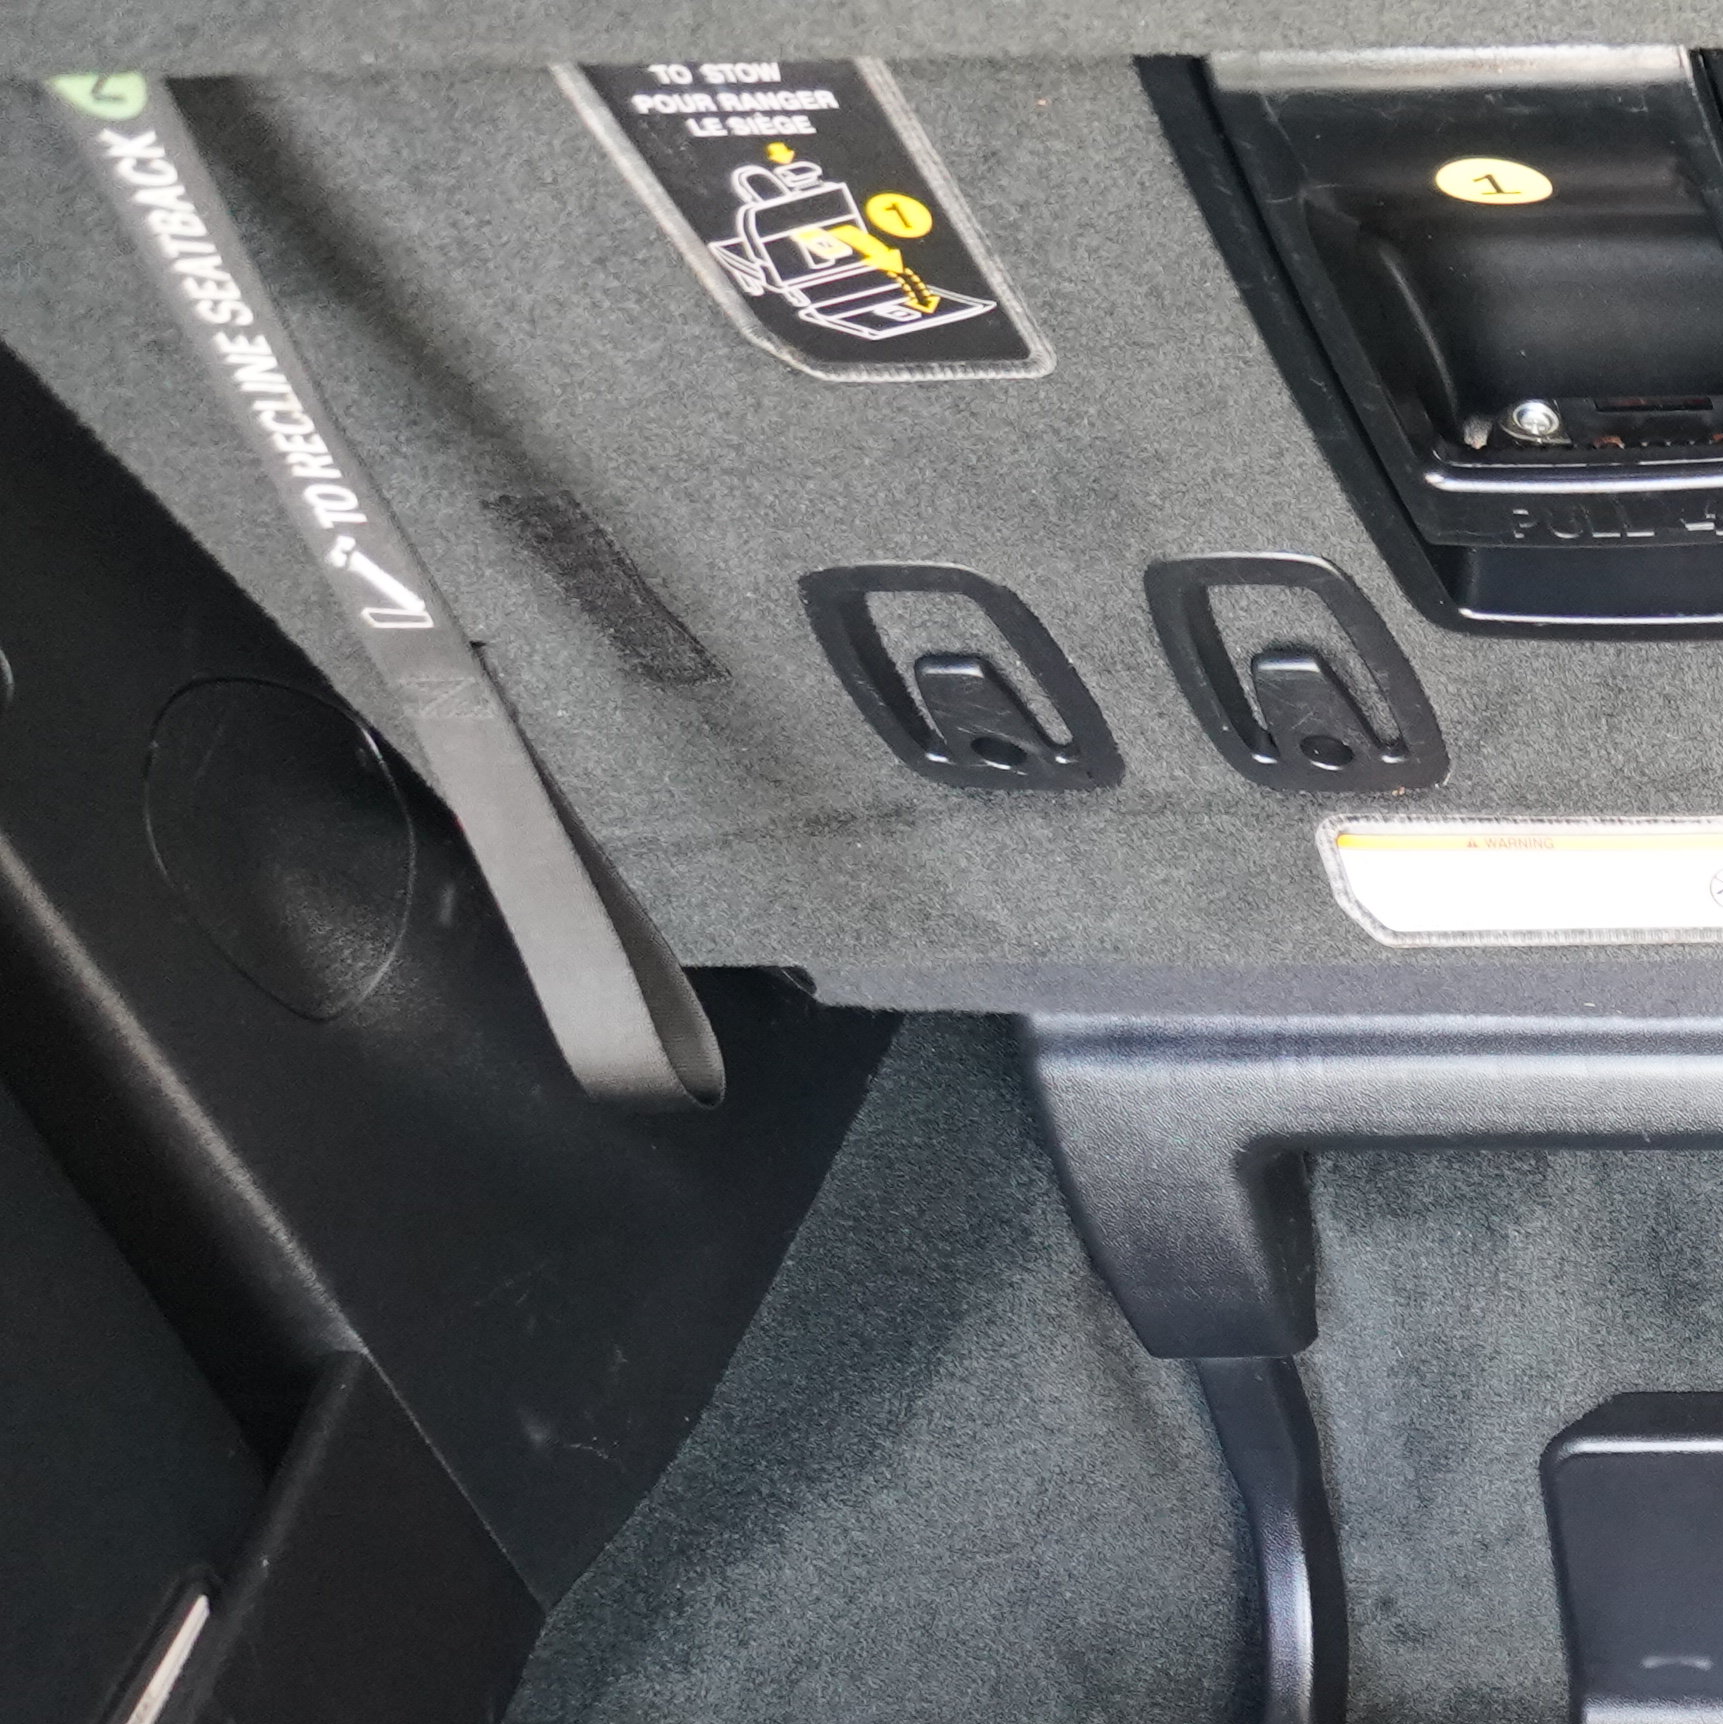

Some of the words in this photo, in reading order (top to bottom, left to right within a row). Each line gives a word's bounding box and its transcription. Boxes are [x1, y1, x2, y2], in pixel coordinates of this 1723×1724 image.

[648, 62, 694, 86] TO
[699, 61, 783, 85] STOW
[631, 91, 718, 115] POUR
[716, 88, 840, 112] RANGER
[684, 116, 729, 138] LE
[725, 111, 818, 137] SIÈGE
[1472, 172, 1523, 196] 1
[99, 127, 255, 327] SEATBACK
[214, 331, 343, 481] RECLINE
[303, 483, 368, 530] TO
[1511, 507, 1657, 541] PULL
[1483, 836, 1555, 849] WARNING
